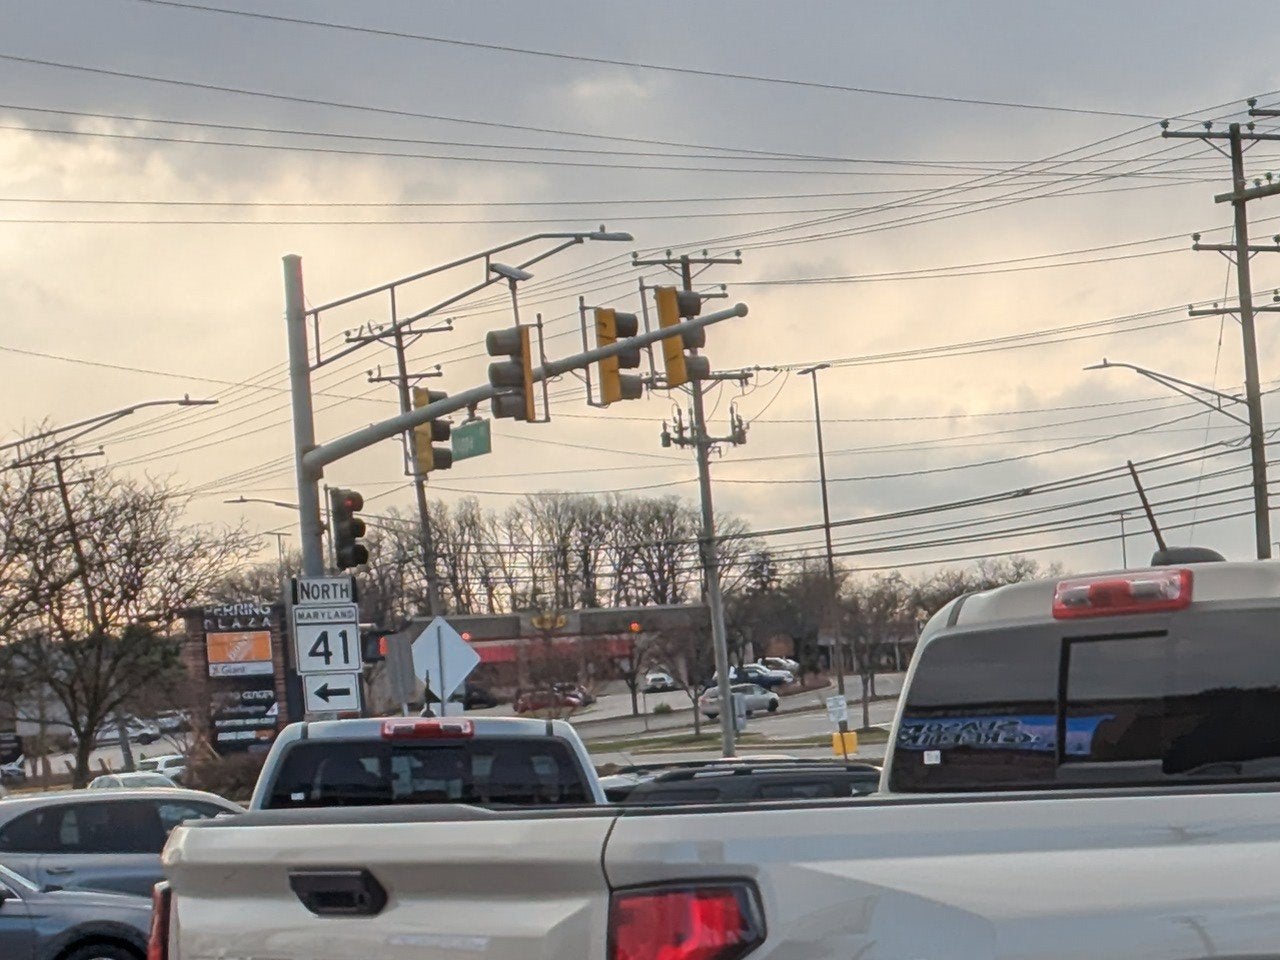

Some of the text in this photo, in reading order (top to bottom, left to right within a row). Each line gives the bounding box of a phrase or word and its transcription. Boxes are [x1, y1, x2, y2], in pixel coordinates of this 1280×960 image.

[300, 582, 349, 600] NORTH
[298, 609, 354, 620] MARYLAND
[308, 630, 349, 665] 41
